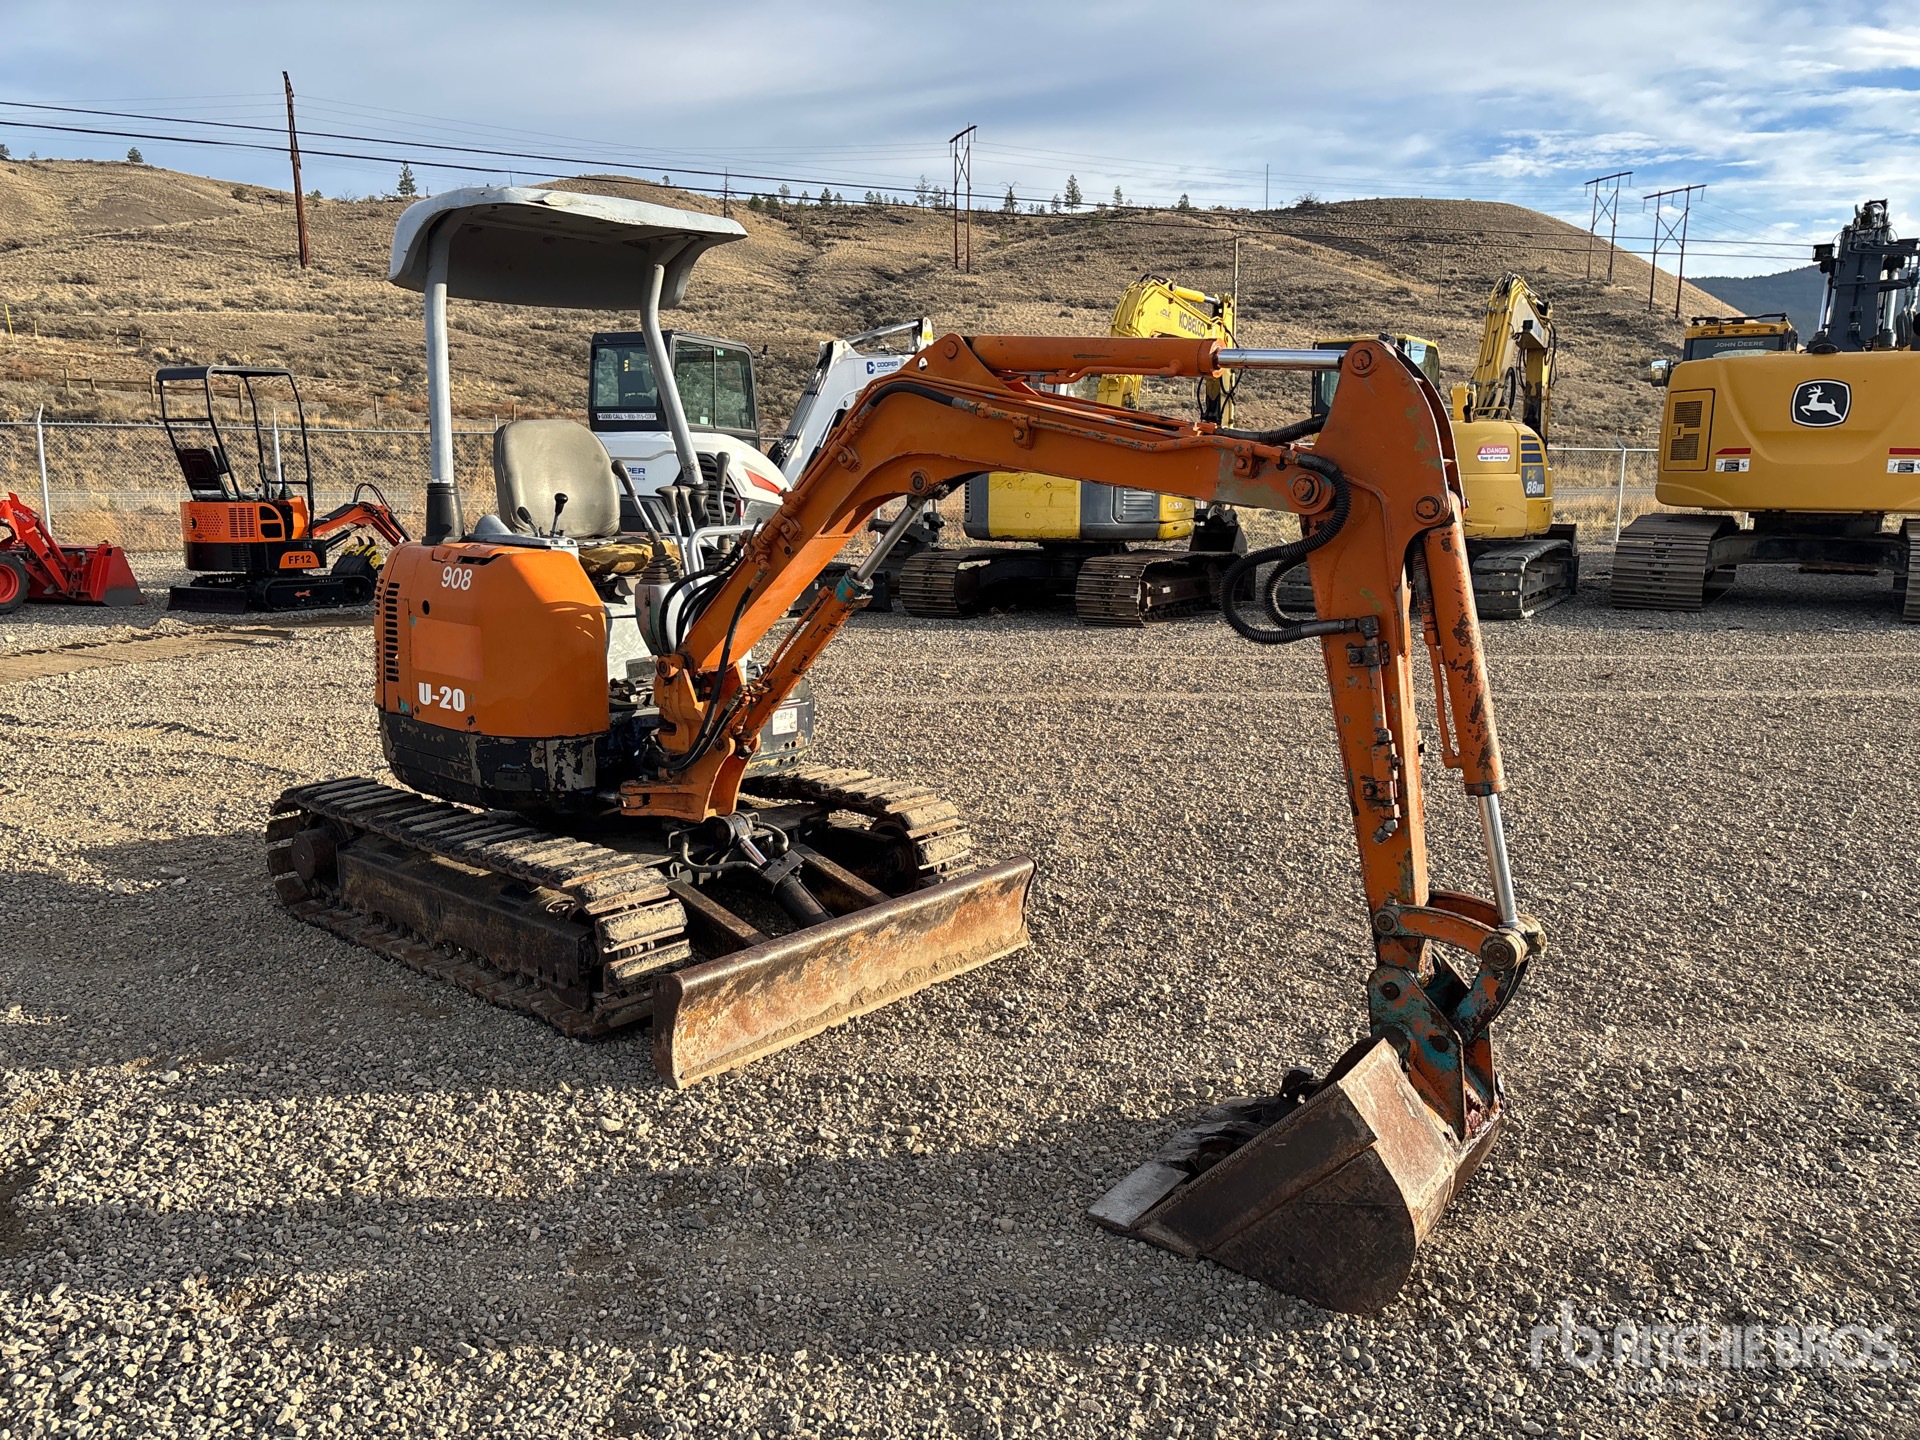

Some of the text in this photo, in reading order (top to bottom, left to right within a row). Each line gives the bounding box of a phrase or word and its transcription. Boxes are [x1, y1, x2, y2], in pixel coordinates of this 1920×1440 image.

[1179, 310, 1206, 338] KOBELCO
[288, 555, 312, 565] FF12
[441, 566, 473, 591] 908
[418, 682, 466, 712] U-20
